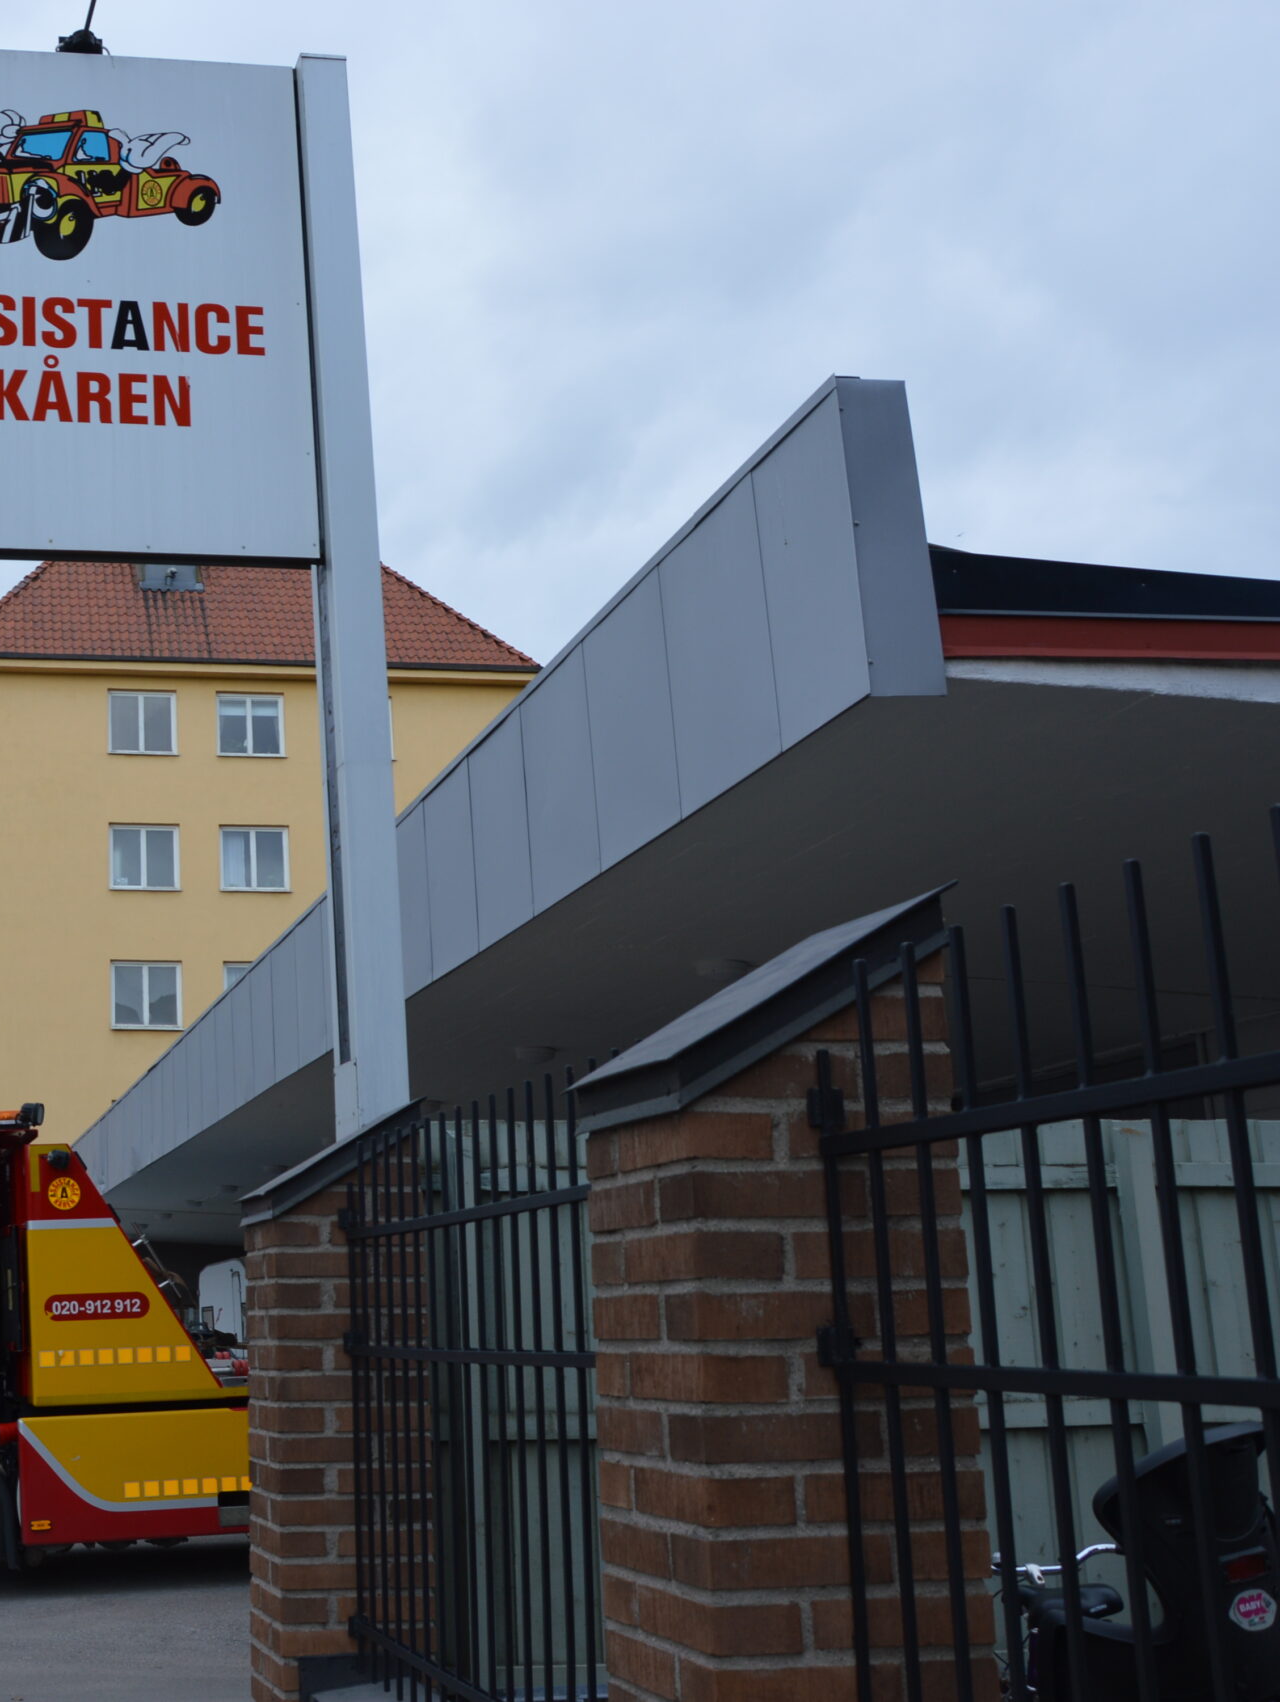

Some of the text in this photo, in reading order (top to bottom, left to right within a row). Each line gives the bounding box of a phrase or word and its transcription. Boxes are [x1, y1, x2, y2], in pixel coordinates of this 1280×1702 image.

[60, 1186, 69, 1199] A
[51, 1298, 141, 1315] 020-912 912
